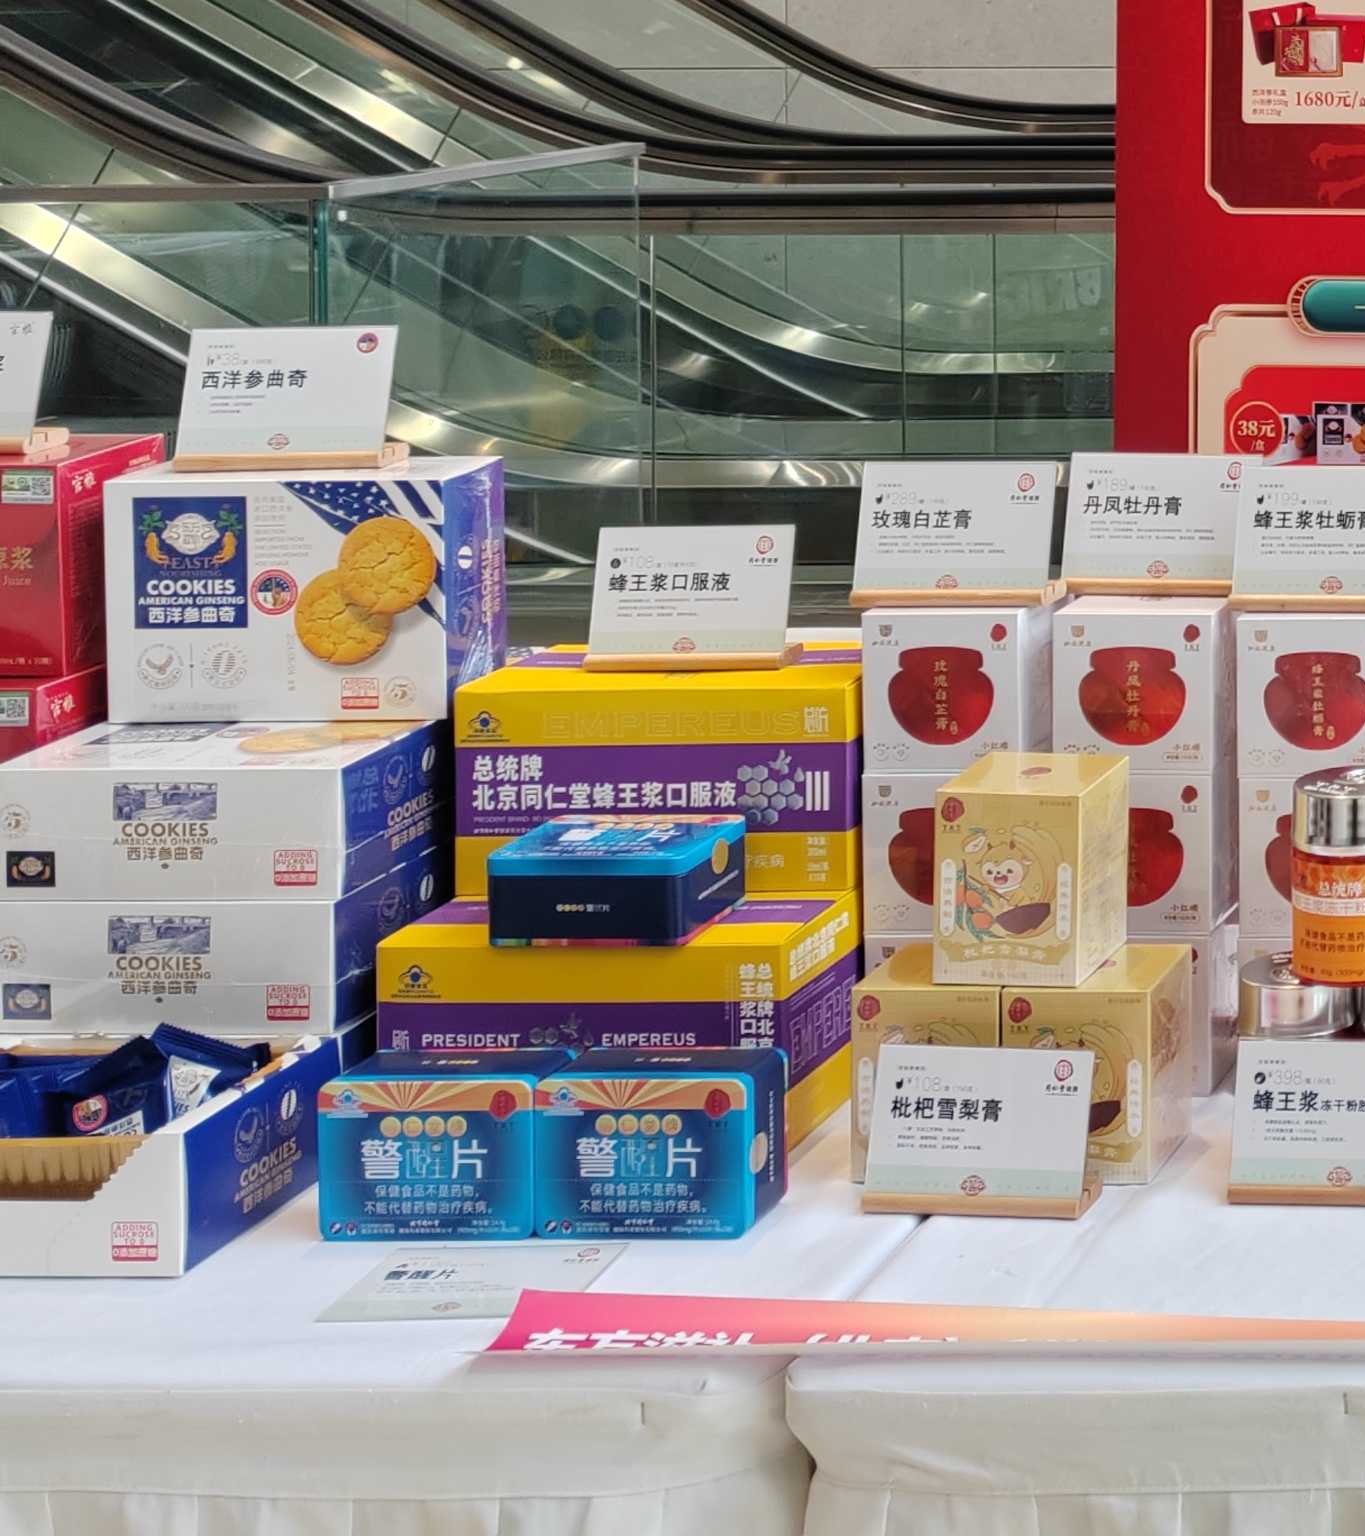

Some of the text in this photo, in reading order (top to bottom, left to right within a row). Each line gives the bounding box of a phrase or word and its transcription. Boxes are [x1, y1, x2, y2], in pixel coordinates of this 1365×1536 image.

[200, 368, 309, 390] 西洋参曲奇
[1236, 419, 1276, 439] 38元
[1082, 495, 1183, 517] 丹凤牡丹膏
[871, 509, 973, 530] 玫瑰白芷膏
[146, 579, 236, 595] COOKIES
[608, 572, 732, 594] 蜂王浆口服液
[138, 596, 245, 606] AMERICAN GINSENG
[148, 606, 236, 624] 西洋参曲奇
[472, 754, 543, 782] 总统牌
[472, 781, 737, 811] 北京同仁堂蜂王浆口服液
[121, 821, 209, 838] COOKIES
[112, 837, 219, 847] AMERICAN GINSENG
[126, 846, 204, 862] 西洋参曲奇
[115, 955, 203, 972] COOKIES
[107, 970, 213, 980] AMERICAN GINSENG
[120, 979, 198, 996] 西洋参曲奇
[421, 1032, 697, 1048] PRESIDENT EMPEREUS
[891, 1095, 1003, 1124] 枇杷雪梨膏
[239, 1139, 298, 1187] COOKIES
[112, 1231, 156, 1239] SUCROSE
[114, 1224, 154, 1233] ADDING
